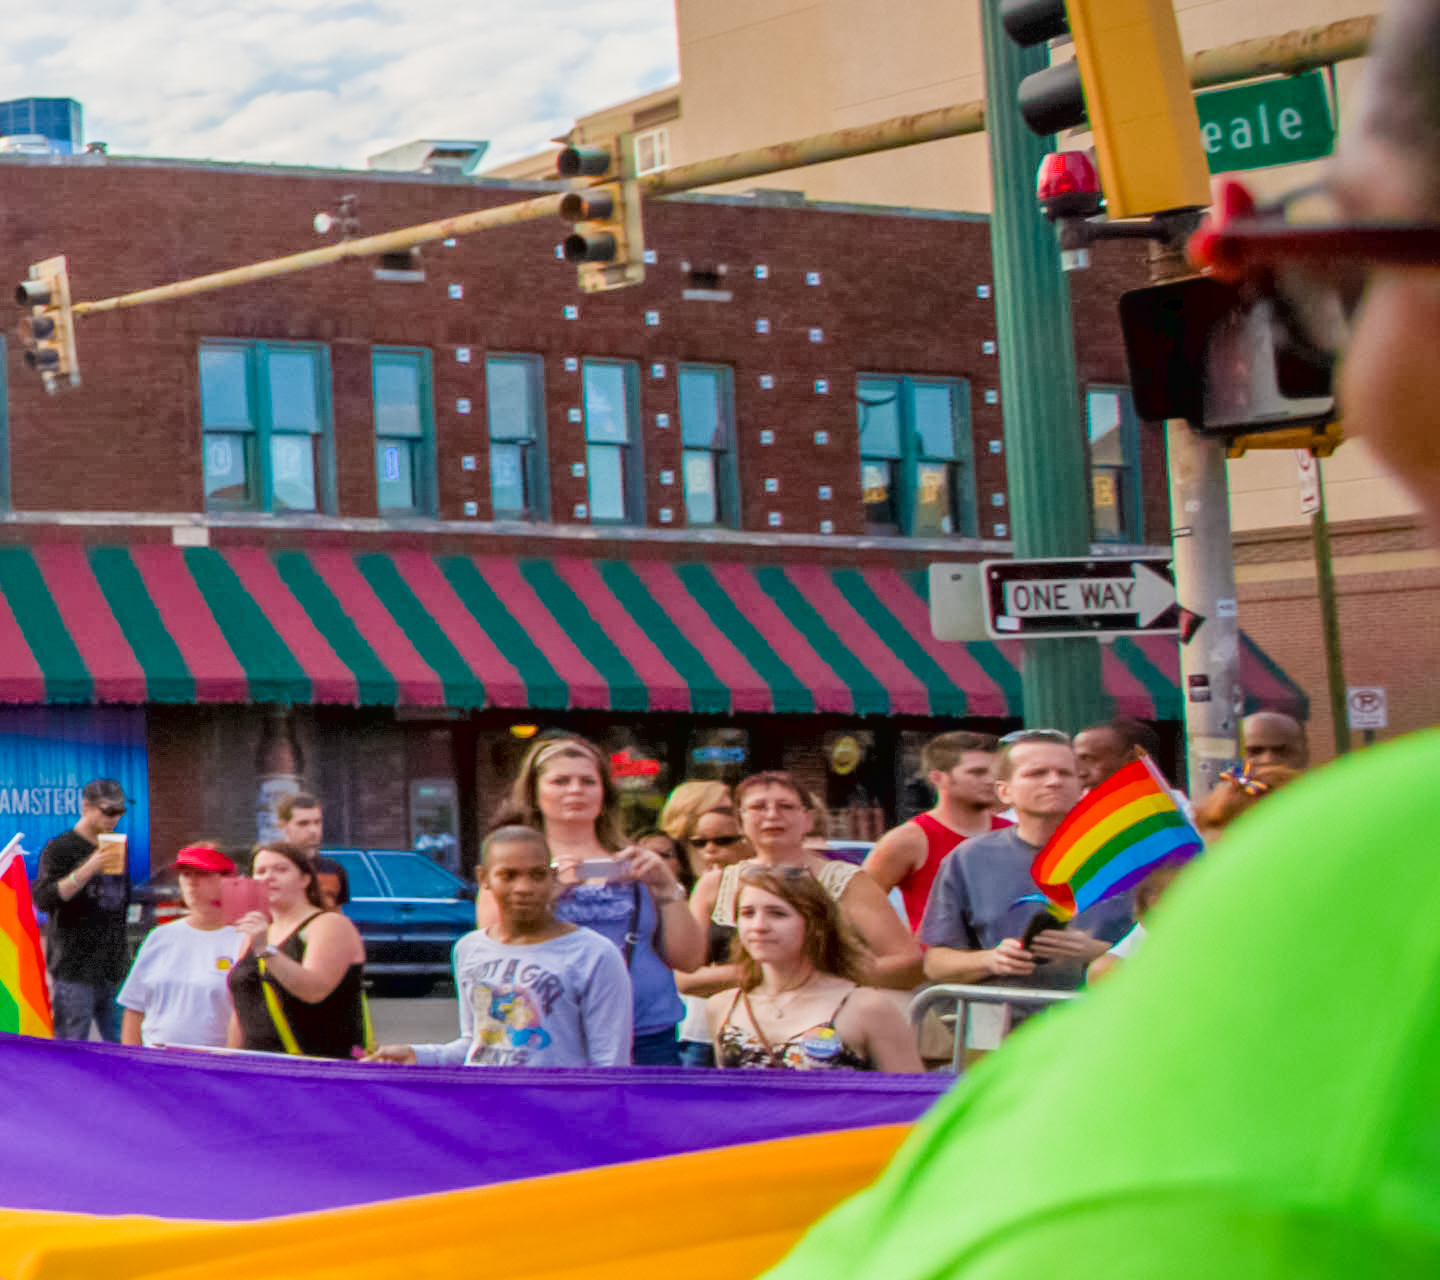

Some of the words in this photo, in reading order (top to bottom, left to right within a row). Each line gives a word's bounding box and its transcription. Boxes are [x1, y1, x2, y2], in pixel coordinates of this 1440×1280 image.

[1201, 103, 1303, 154] eale
[1013, 583, 1070, 612] ONE
[1081, 581, 1135, 609] WAY
